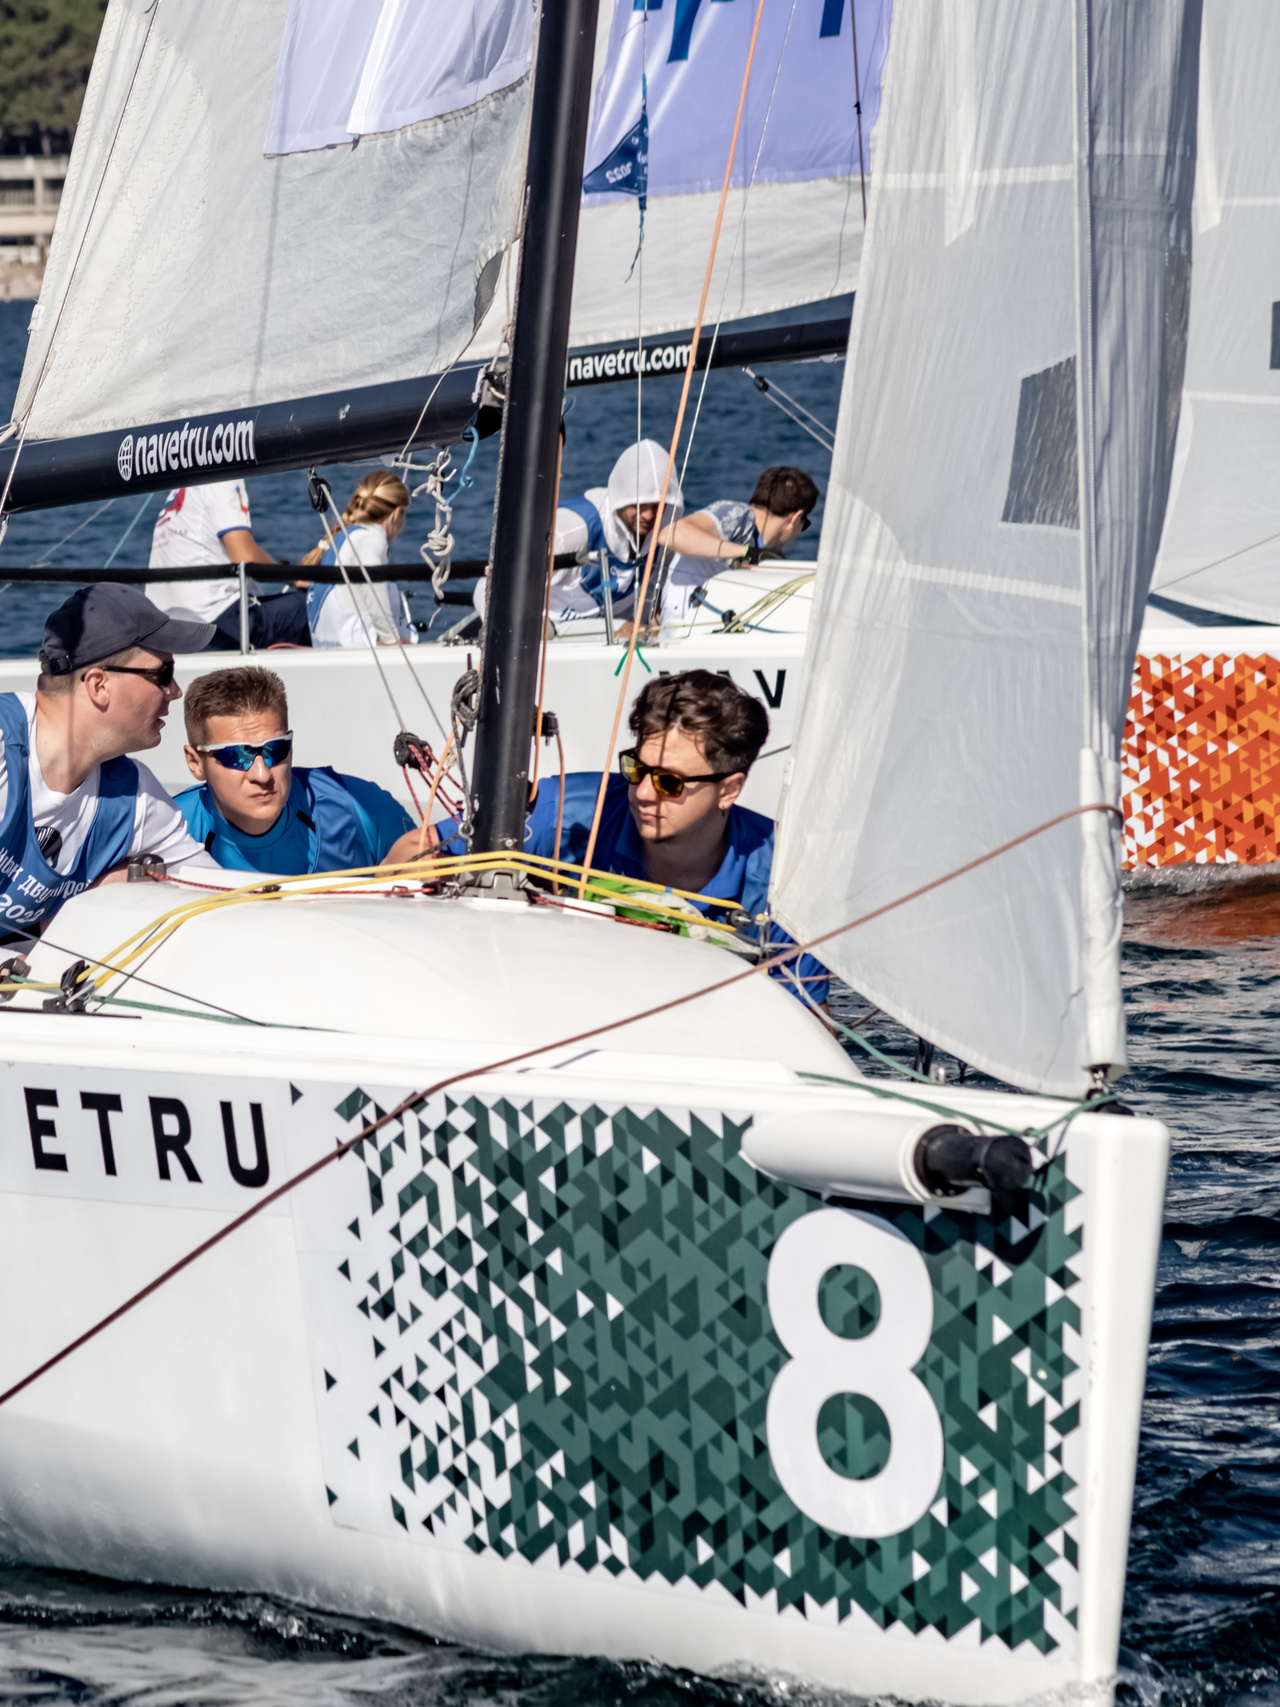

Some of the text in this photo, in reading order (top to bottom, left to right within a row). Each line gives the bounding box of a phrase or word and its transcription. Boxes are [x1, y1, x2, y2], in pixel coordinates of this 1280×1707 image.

[569, 344, 696, 381] navetru.com
[135, 420, 255, 476] navetru.com
[766, 1207, 945, 1539] 8
